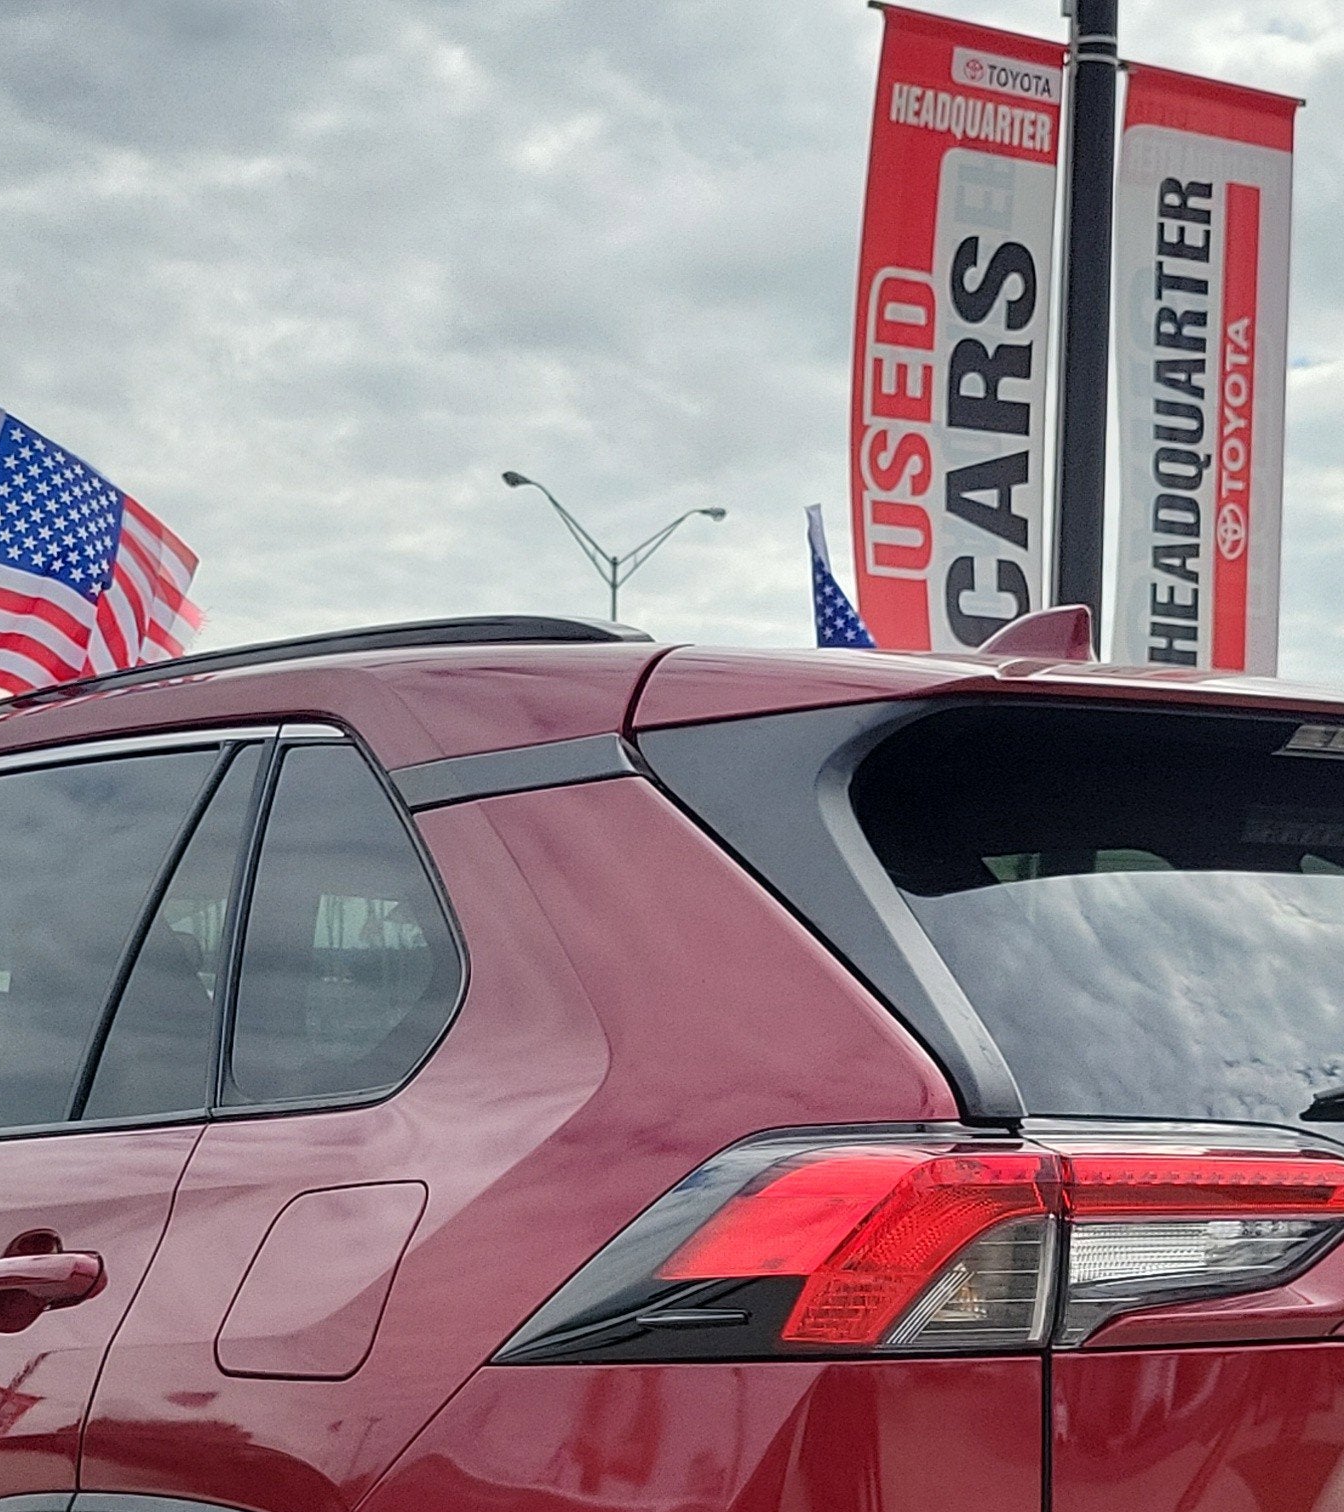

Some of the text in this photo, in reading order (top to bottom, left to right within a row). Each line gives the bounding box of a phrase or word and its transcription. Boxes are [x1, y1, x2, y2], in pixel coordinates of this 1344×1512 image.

[890, 82, 1053, 152] HEADQUARTER
[987, 63, 1053, 98] TOYOTA
[867, 272, 937, 574] USED
[944, 236, 1037, 649] CARS
[1148, 176, 1214, 668] HEADQUARTER
[1221, 317, 1251, 499] TOYOTA
